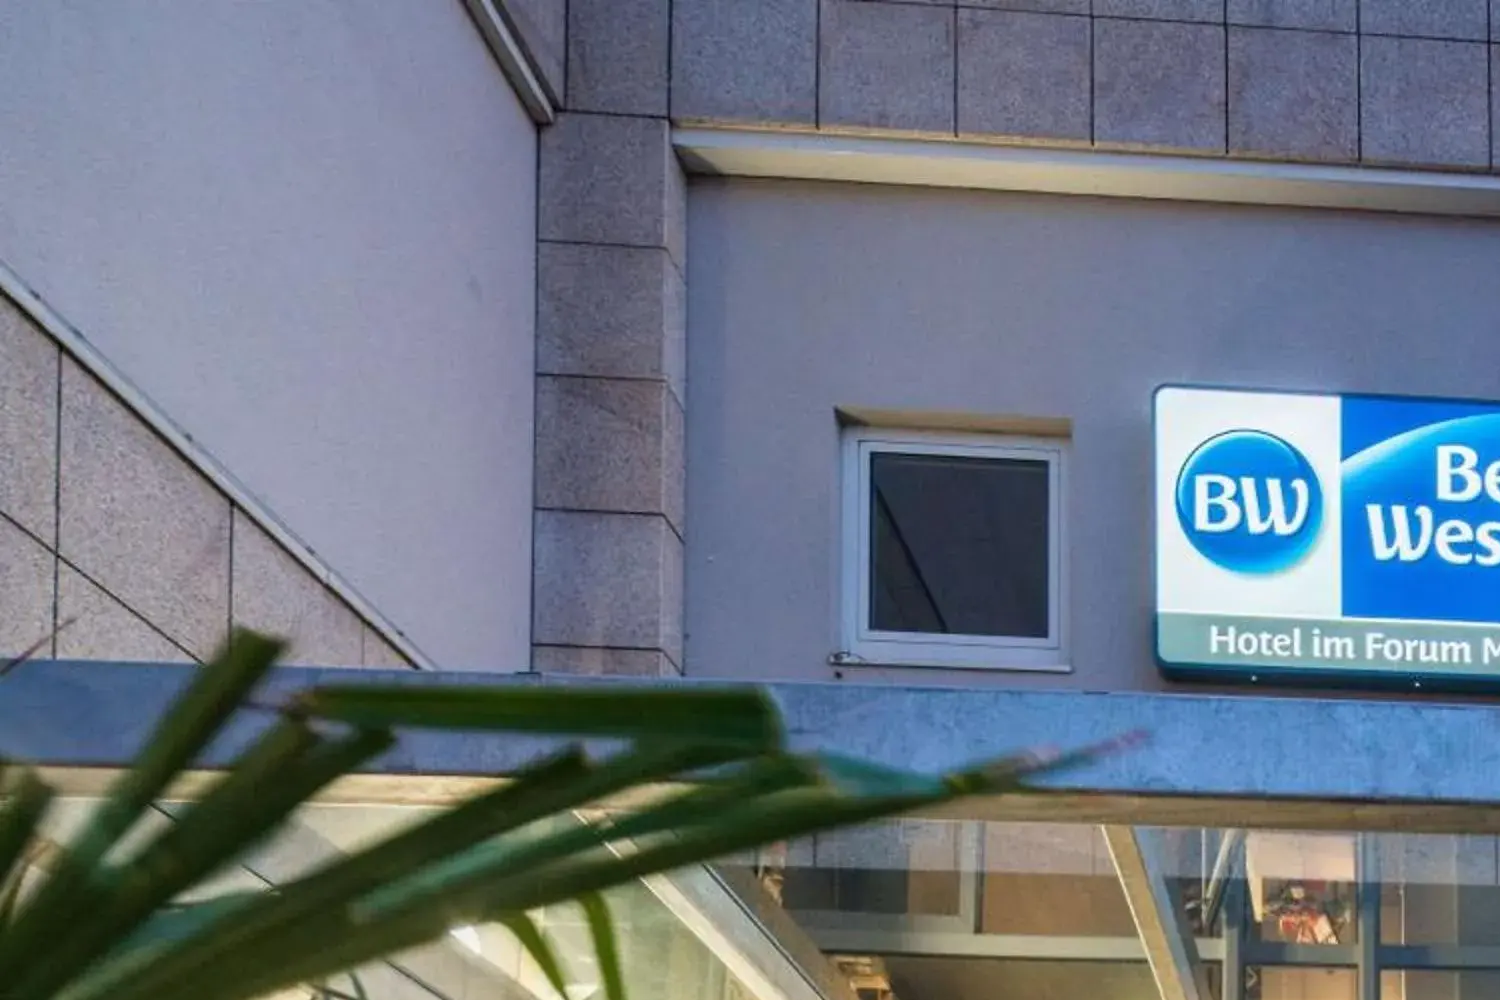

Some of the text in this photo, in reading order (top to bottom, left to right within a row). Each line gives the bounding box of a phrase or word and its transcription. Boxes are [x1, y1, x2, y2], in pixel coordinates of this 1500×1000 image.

[1193, 474, 1310, 537] BW
[1209, 625, 1301, 658] Hotel
[1312, 628, 1356, 661] im
[1365, 631, 1472, 665] Forum
